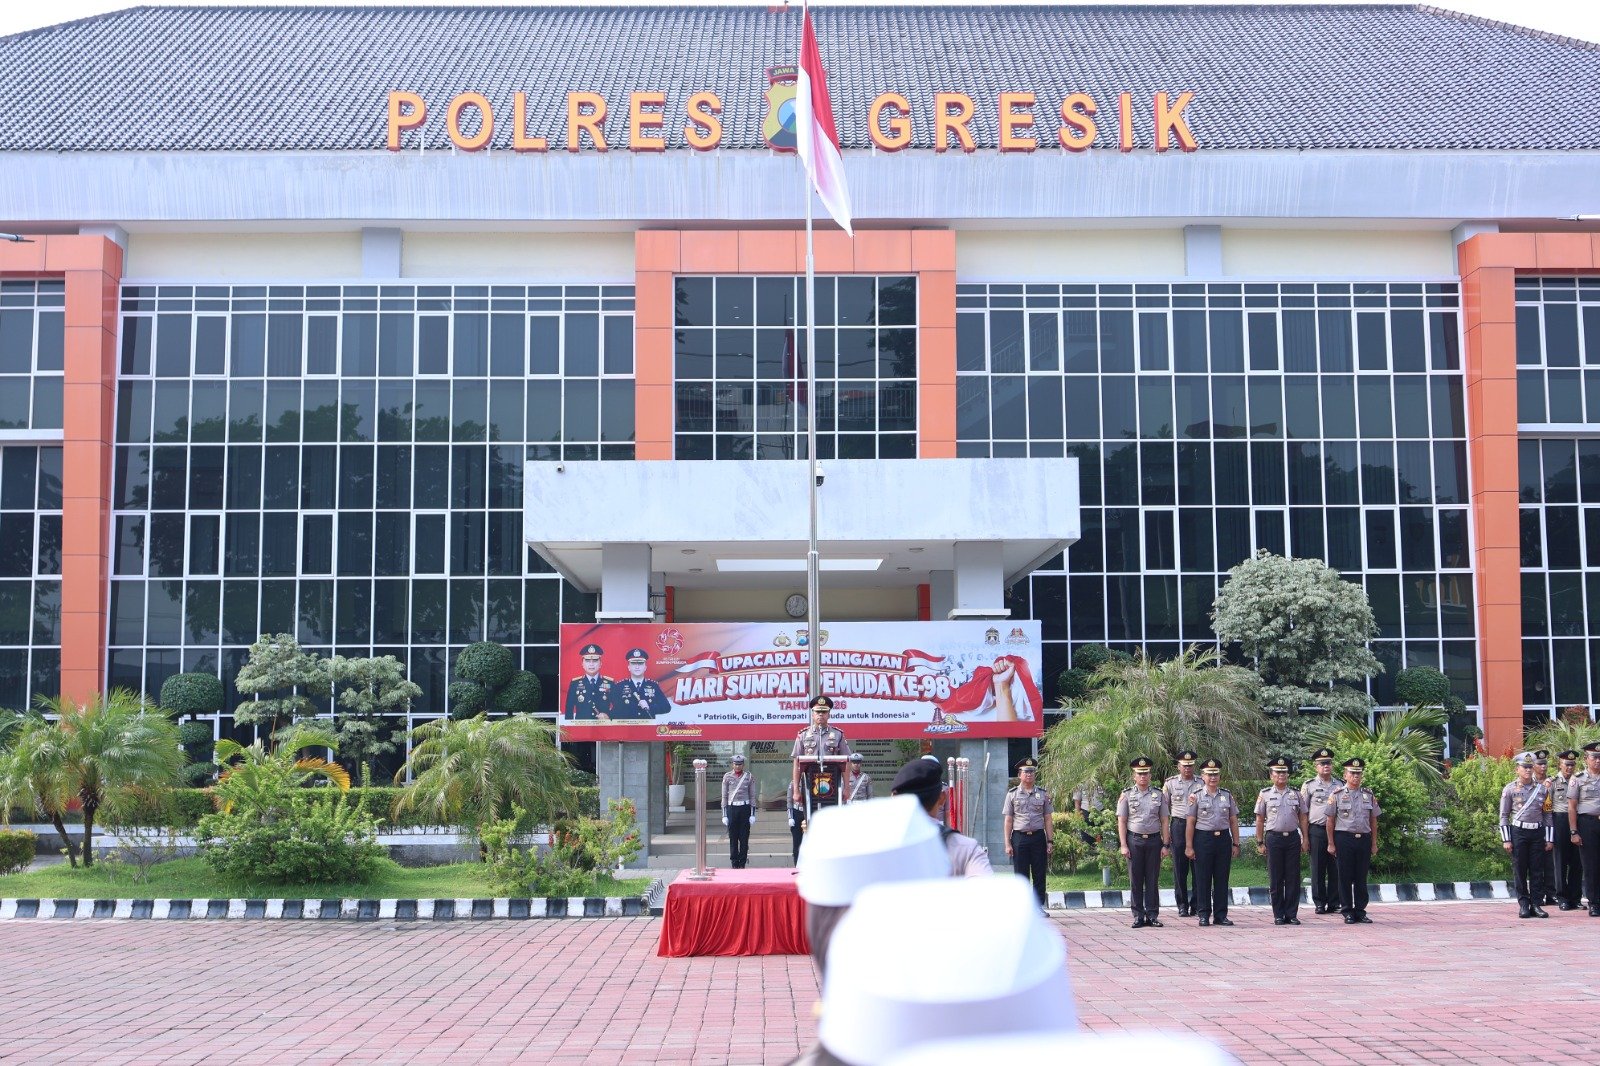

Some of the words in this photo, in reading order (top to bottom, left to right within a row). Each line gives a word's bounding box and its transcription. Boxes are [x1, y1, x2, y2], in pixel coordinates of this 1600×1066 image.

[773, 67, 795, 76] JAWA
[387, 91, 723, 152] POLRES
[868, 91, 1198, 153] GRESIK
[722, 652, 797, 670] UPACARA
[800, 652, 902, 669] PRINGATAN
[675, 676, 723, 702] HARI
[726, 672, 806, 697] SUMPAH
[895, 674, 950, 700] KE-98
[704, 713, 739, 721] Patriotik,
[742, 713, 764, 721] Gigih,
[847, 711, 870, 719] untuk
[872, 711, 909, 719] Indonesia
[750, 741, 775, 750] POLISI
